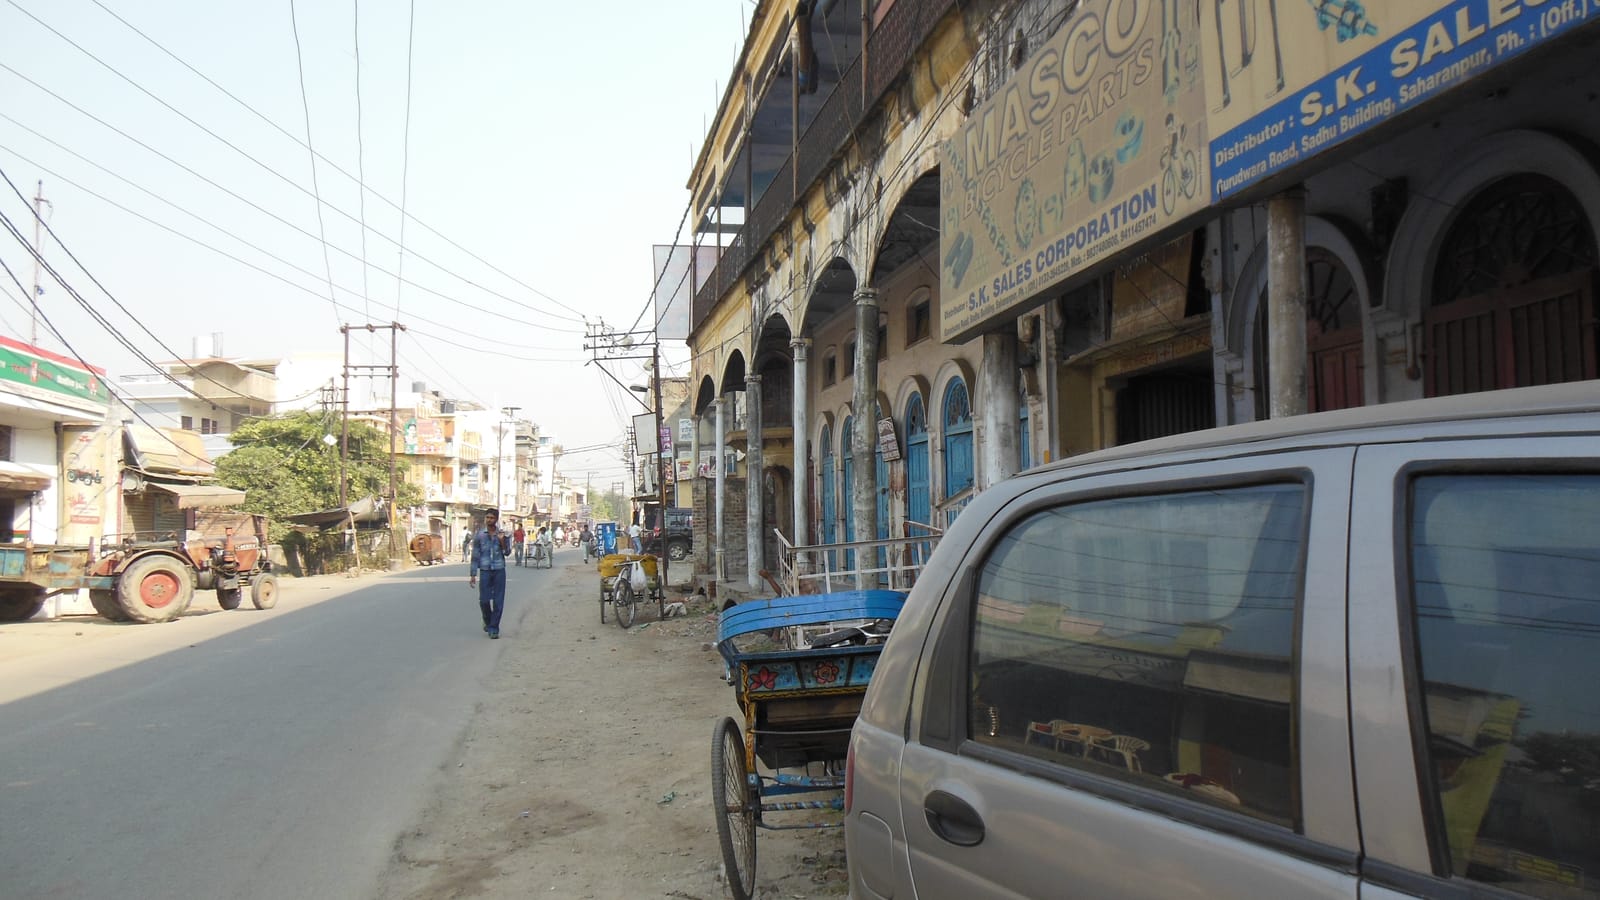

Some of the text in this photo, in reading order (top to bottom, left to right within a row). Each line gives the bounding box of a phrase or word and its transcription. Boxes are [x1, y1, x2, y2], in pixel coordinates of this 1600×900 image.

[962, 38, 1154, 220] BICYCLE PARTS
[964, 0, 1151, 182] MASCO
[1215, 117, 1286, 167] Distributor
[1300, 65, 1376, 127] S.K.
[1391, 0, 1549, 77] SALE
[1215, 160, 1267, 195] Gurudwara
[1269, 141, 1299, 168] Road,
[1302, 125, 1337, 152] Sadhu
[1340, 95, 1396, 133] Building,
[1399, 47, 1491, 103] Saharanpur,
[1496, 30, 1524, 56] Ph.
[1541, 0, 1588, 37] (Off.)
[968, 285, 989, 311] S.K.
[993, 262, 1032, 298] SALES
[1036, 184, 1157, 273] CORPORATION
